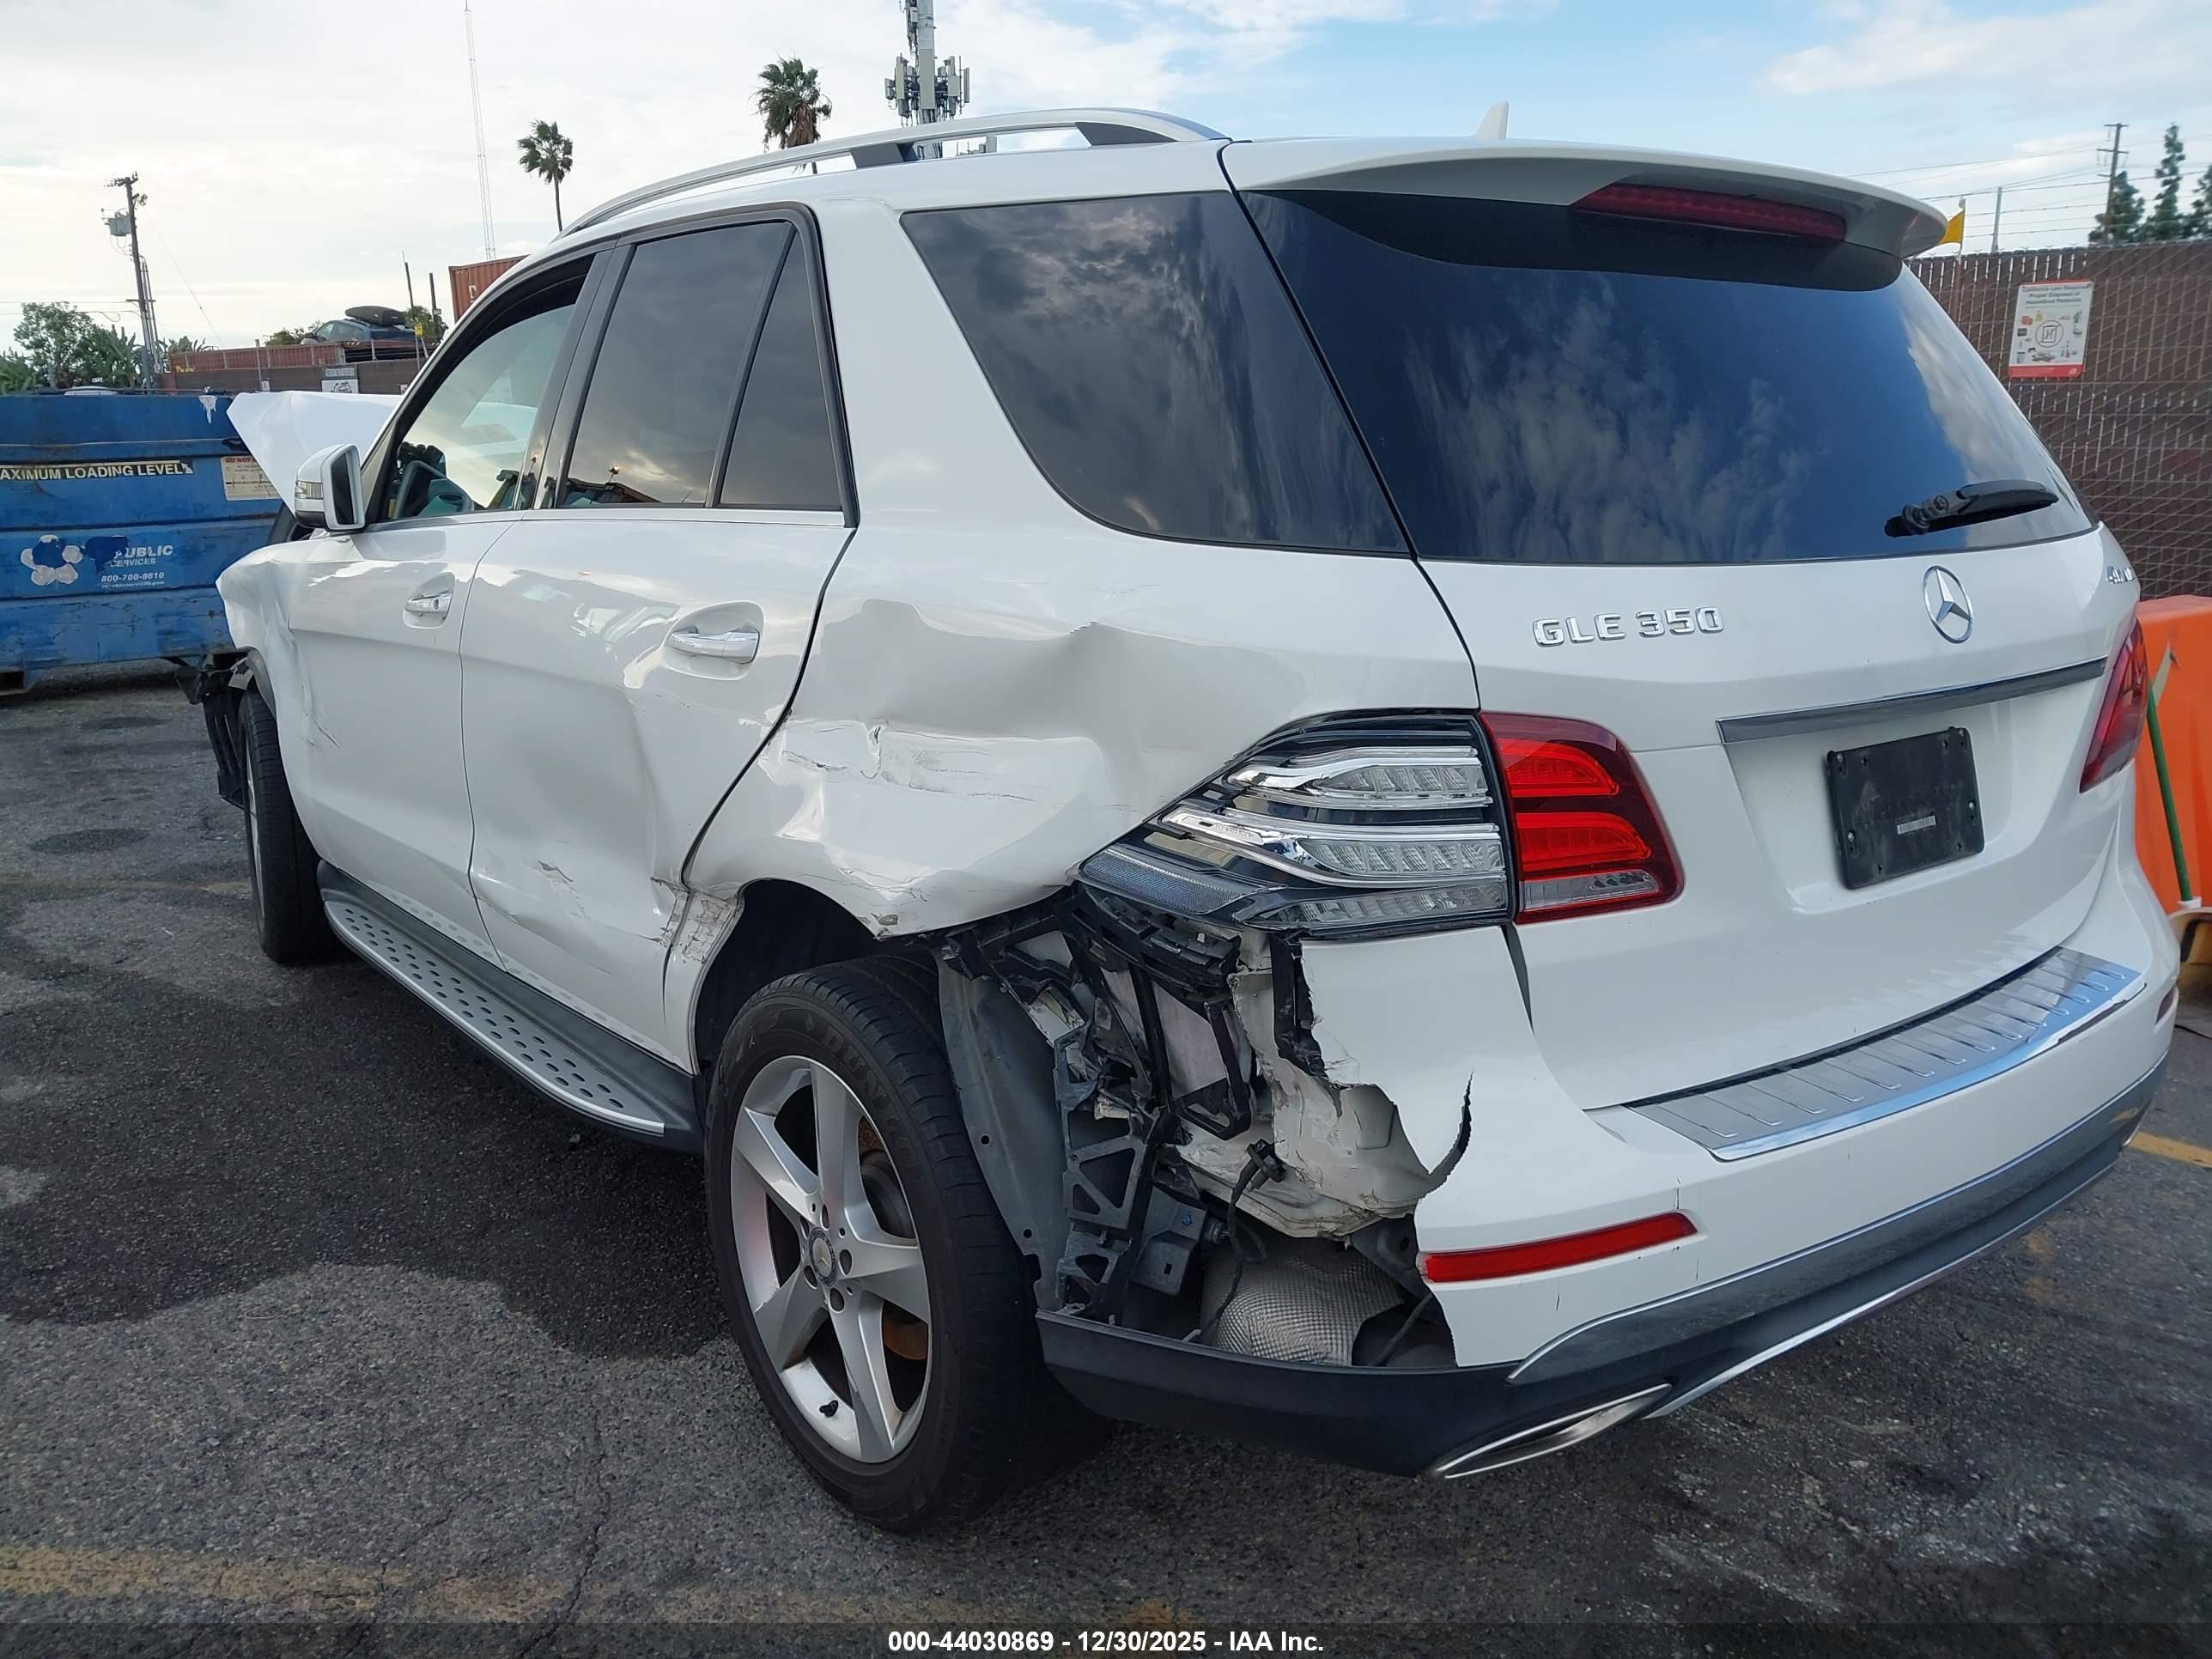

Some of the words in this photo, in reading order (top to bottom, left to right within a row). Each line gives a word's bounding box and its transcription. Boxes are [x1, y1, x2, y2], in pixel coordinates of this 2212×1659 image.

[0, 468, 61, 481] AXIMUM
[66, 465, 133, 478] LOADING
[1533, 612, 1626, 647] GLE
[1636, 606, 1724, 638] 350
